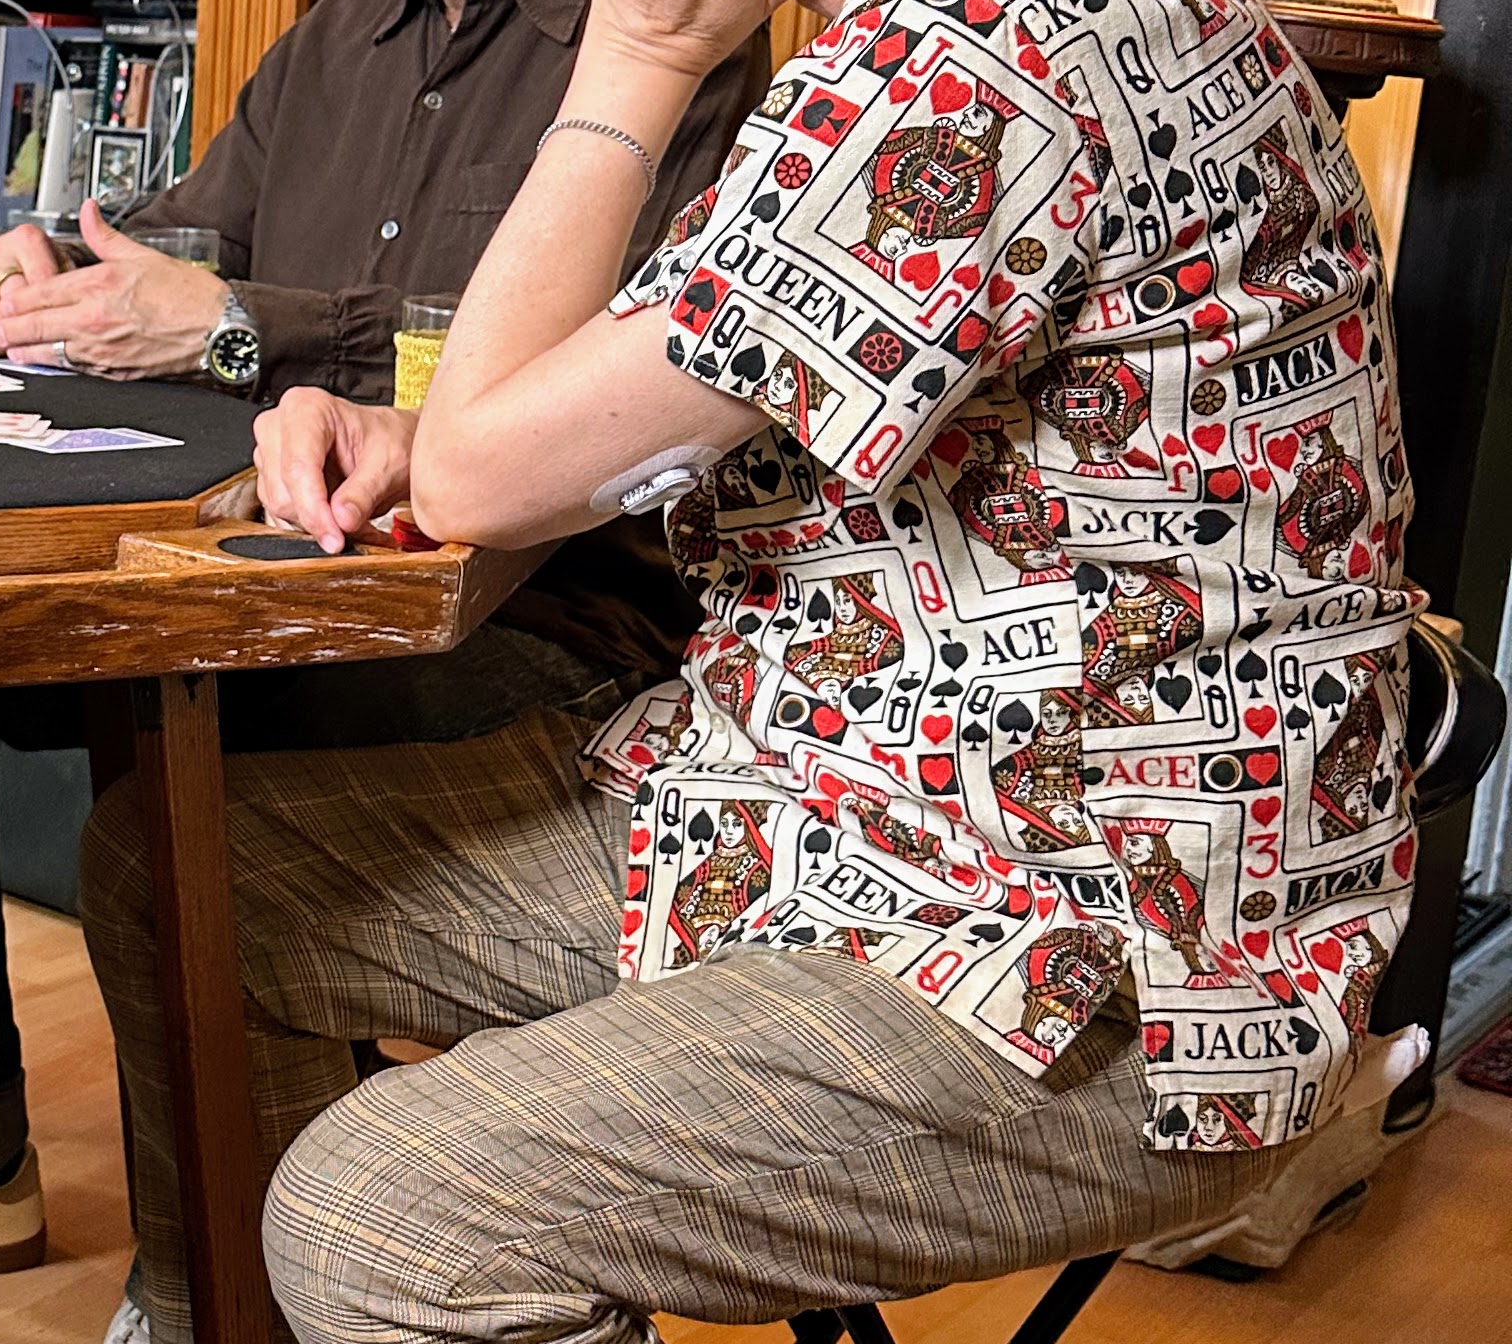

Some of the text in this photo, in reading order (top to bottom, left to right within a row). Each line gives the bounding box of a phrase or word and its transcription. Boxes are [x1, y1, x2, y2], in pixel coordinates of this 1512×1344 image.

[906, 36, 955, 77] J
[1116, 37, 1154, 93] Q
[1186, 69, 1246, 141] ACE
[1050, 170, 1100, 230] 3
[1201, 158, 1228, 203] Q
[1136, 215, 1160, 256] Q
[714, 234, 865, 342] QUEEN
[914, 288, 963, 329] J
[712, 304, 746, 349] Q
[1240, 336, 1335, 403] JACK
[854, 424, 902, 480] Q
[1240, 422, 1261, 465] J
[791, 463, 814, 505] Q
[1167, 461, 1193, 492] J
[784, 572, 801, 611] Q
[912, 561, 948, 613] Q
[1281, 589, 1368, 634] ACE
[981, 616, 1059, 666] ACE
[1279, 655, 1303, 698] Q
[888, 696, 912, 734] Q
[967, 684, 995, 715] Q
[1204, 685, 1228, 729] Q
[677, 761, 756, 777] ACE
[1105, 755, 1196, 788] ACE
[662, 788, 681, 827] Q
[1245, 833, 1279, 879] 3
[1288, 858, 1379, 915] JACK
[1284, 928, 1303, 970] J
[917, 950, 963, 995] Q
[1185, 1019, 1289, 1059] JACK
[1294, 1081, 1317, 1132] Q
